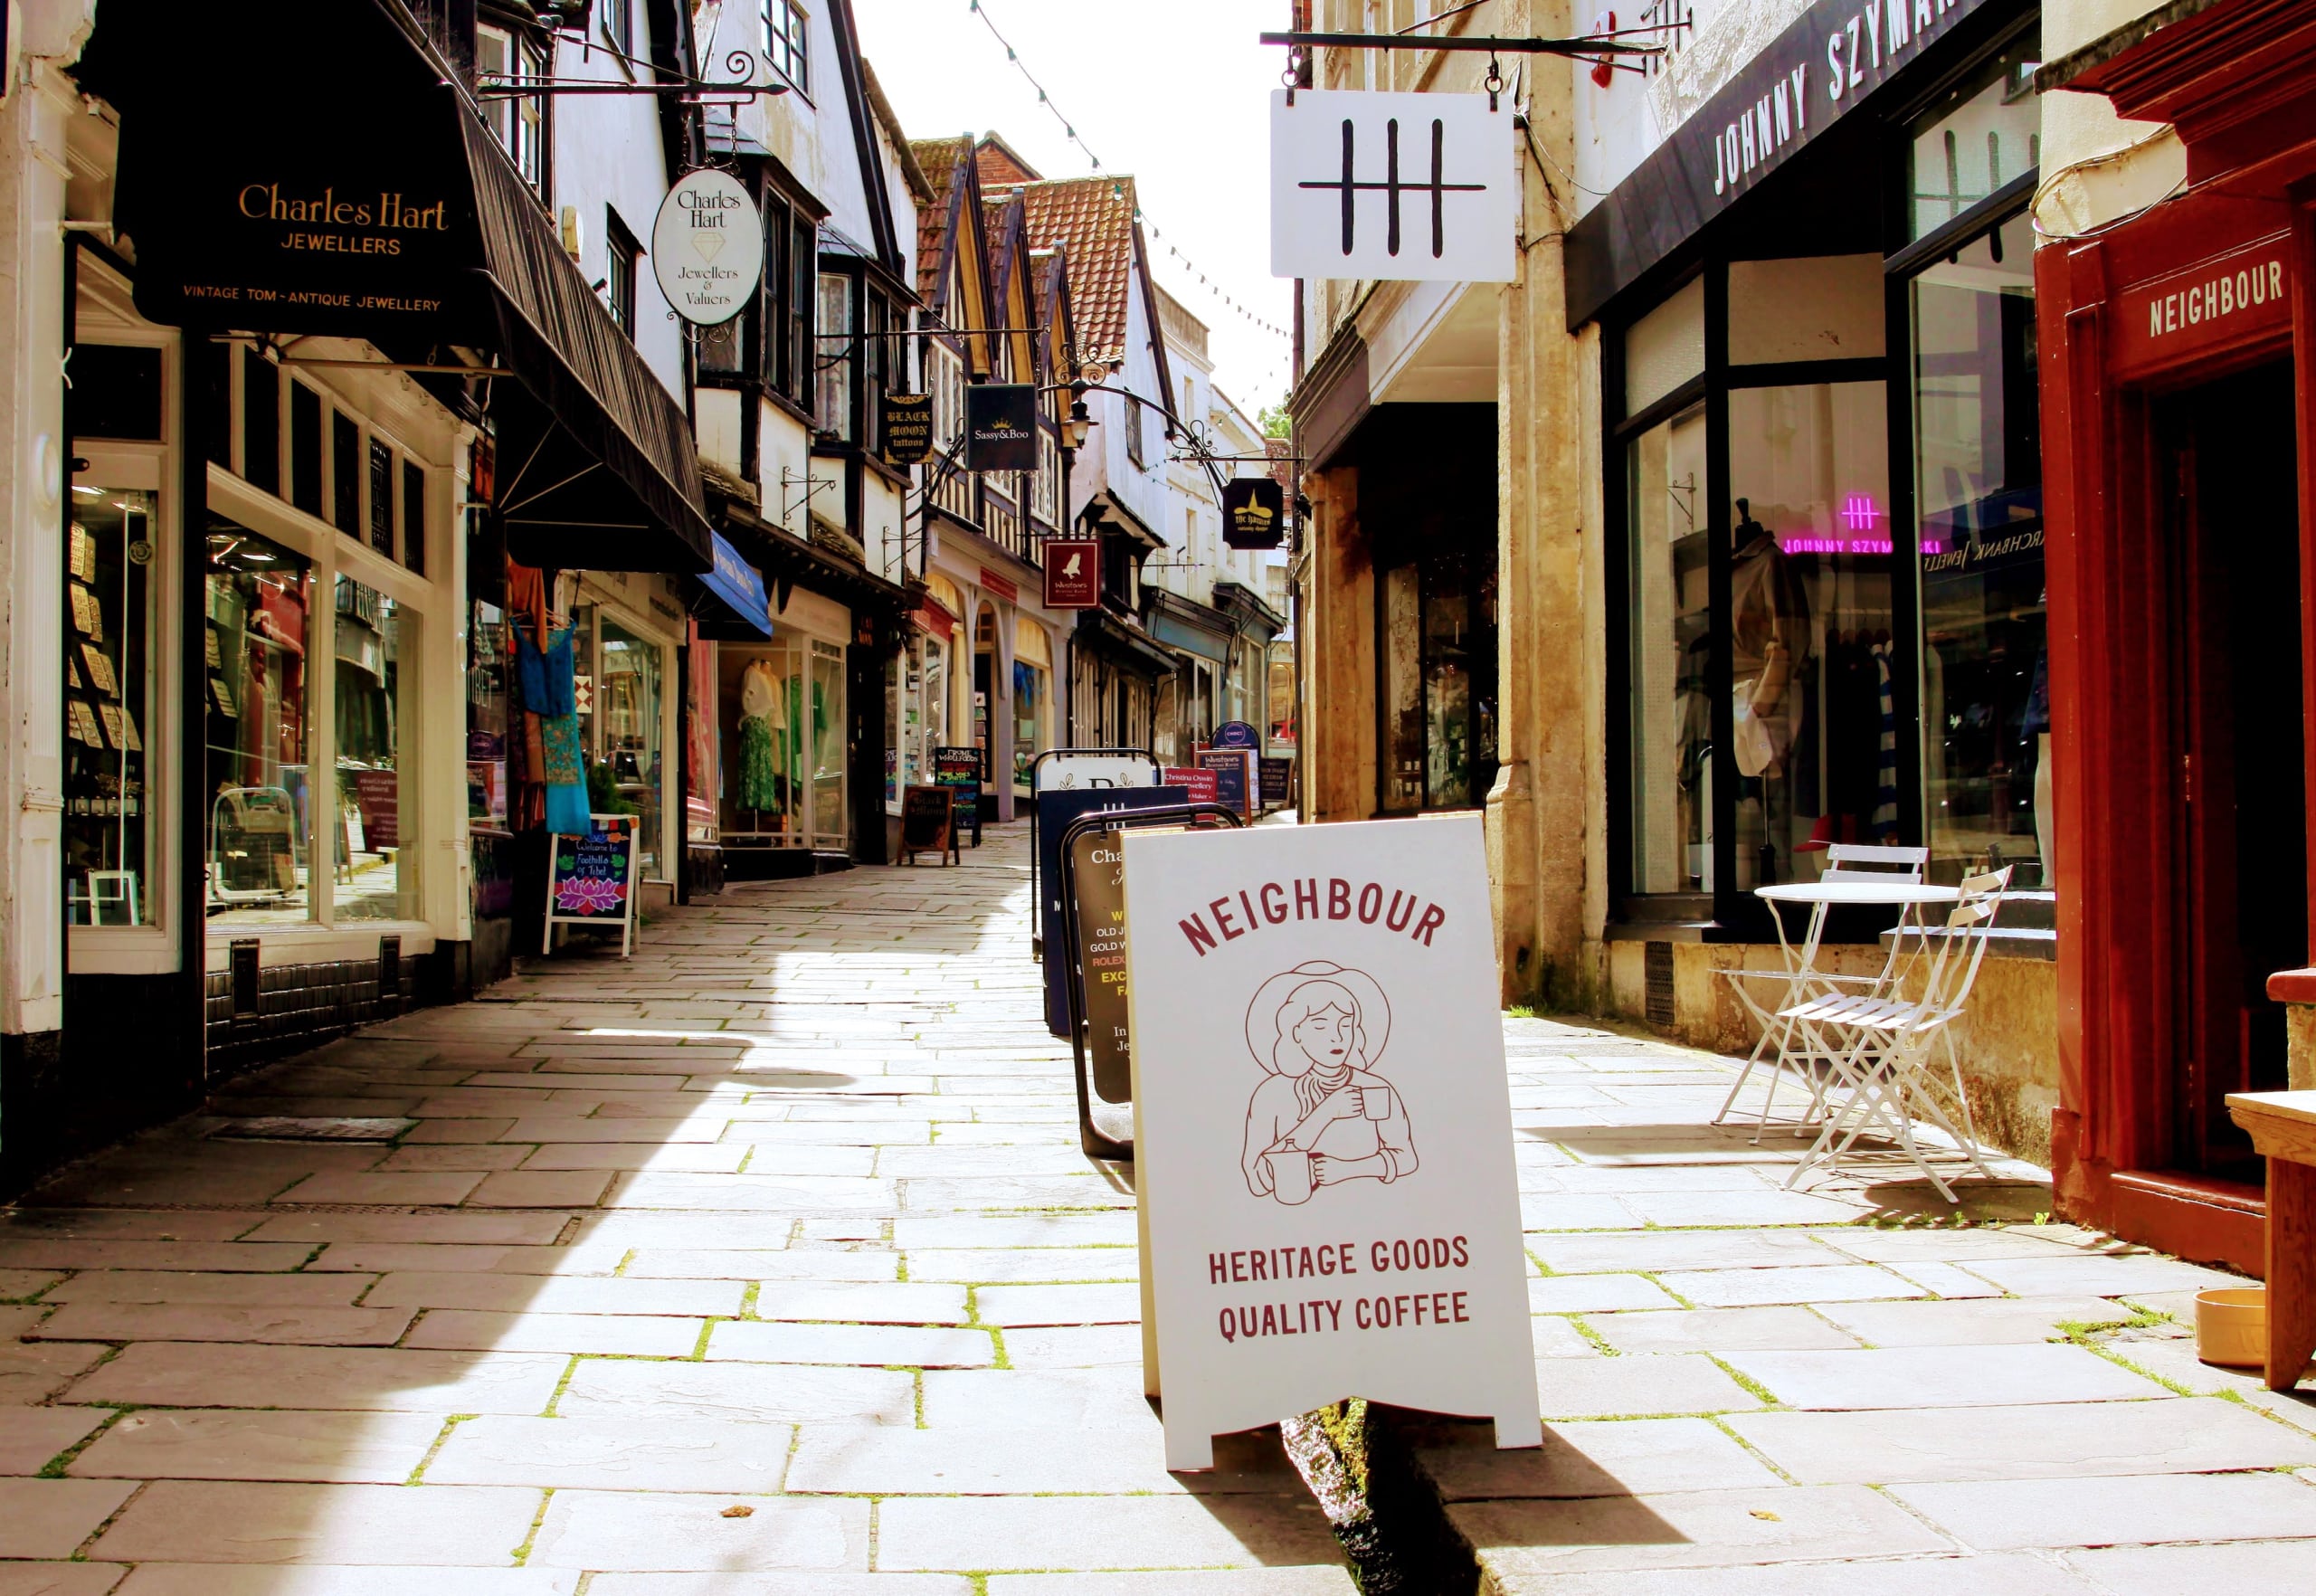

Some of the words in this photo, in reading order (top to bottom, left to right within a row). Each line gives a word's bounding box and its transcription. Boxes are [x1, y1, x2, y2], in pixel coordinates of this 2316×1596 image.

[1715, 62, 1807, 195] JOHNNY
[678, 189, 741, 209] Charles
[239, 182, 372, 226] Charles
[378, 192, 449, 231] Hart
[690, 209, 726, 228] Hart
[280, 233, 401, 255] JEWELLERS
[678, 266, 739, 280] Jewellers
[703, 280, 712, 290] &
[184, 285, 240, 299] VINTAGE
[247, 288, 277, 302] TOM
[288, 292, 351, 307] ANTIQUE
[356, 296, 441, 311] JEWELLERY
[686, 291, 731, 305] Valuers
[2150, 261, 2283, 338] NEIGHBOUR
[887, 411, 930, 423] BLACK
[888, 425, 928, 438] MOON
[974, 429, 1029, 442] Sassy&Boo
[893, 439, 924, 447] tattoos
[1783, 539, 1845, 554] JOHNNY
[575, 840, 608, 852] Welcome
[609, 843, 618, 852] to
[576, 853, 609, 864] Foothills
[1091, 849, 1123, 864] Cha
[577, 867, 585, 878] of
[588, 865, 607, 876] Tibet
[1178, 878, 1447, 957] NEIGHBOUR
[1096, 927, 1116, 937] OLD
[1090, 941, 1117, 953] GOLD
[1092, 955, 1125, 967] ROLEX
[1101, 971, 1126, 983] EXC
[1209, 1242, 1357, 1285] HERITAGE
[1371, 1235, 1470, 1272] GOODS
[1219, 1299, 1343, 1344] QUALITY
[1355, 1291, 1470, 1330] COFFEE
